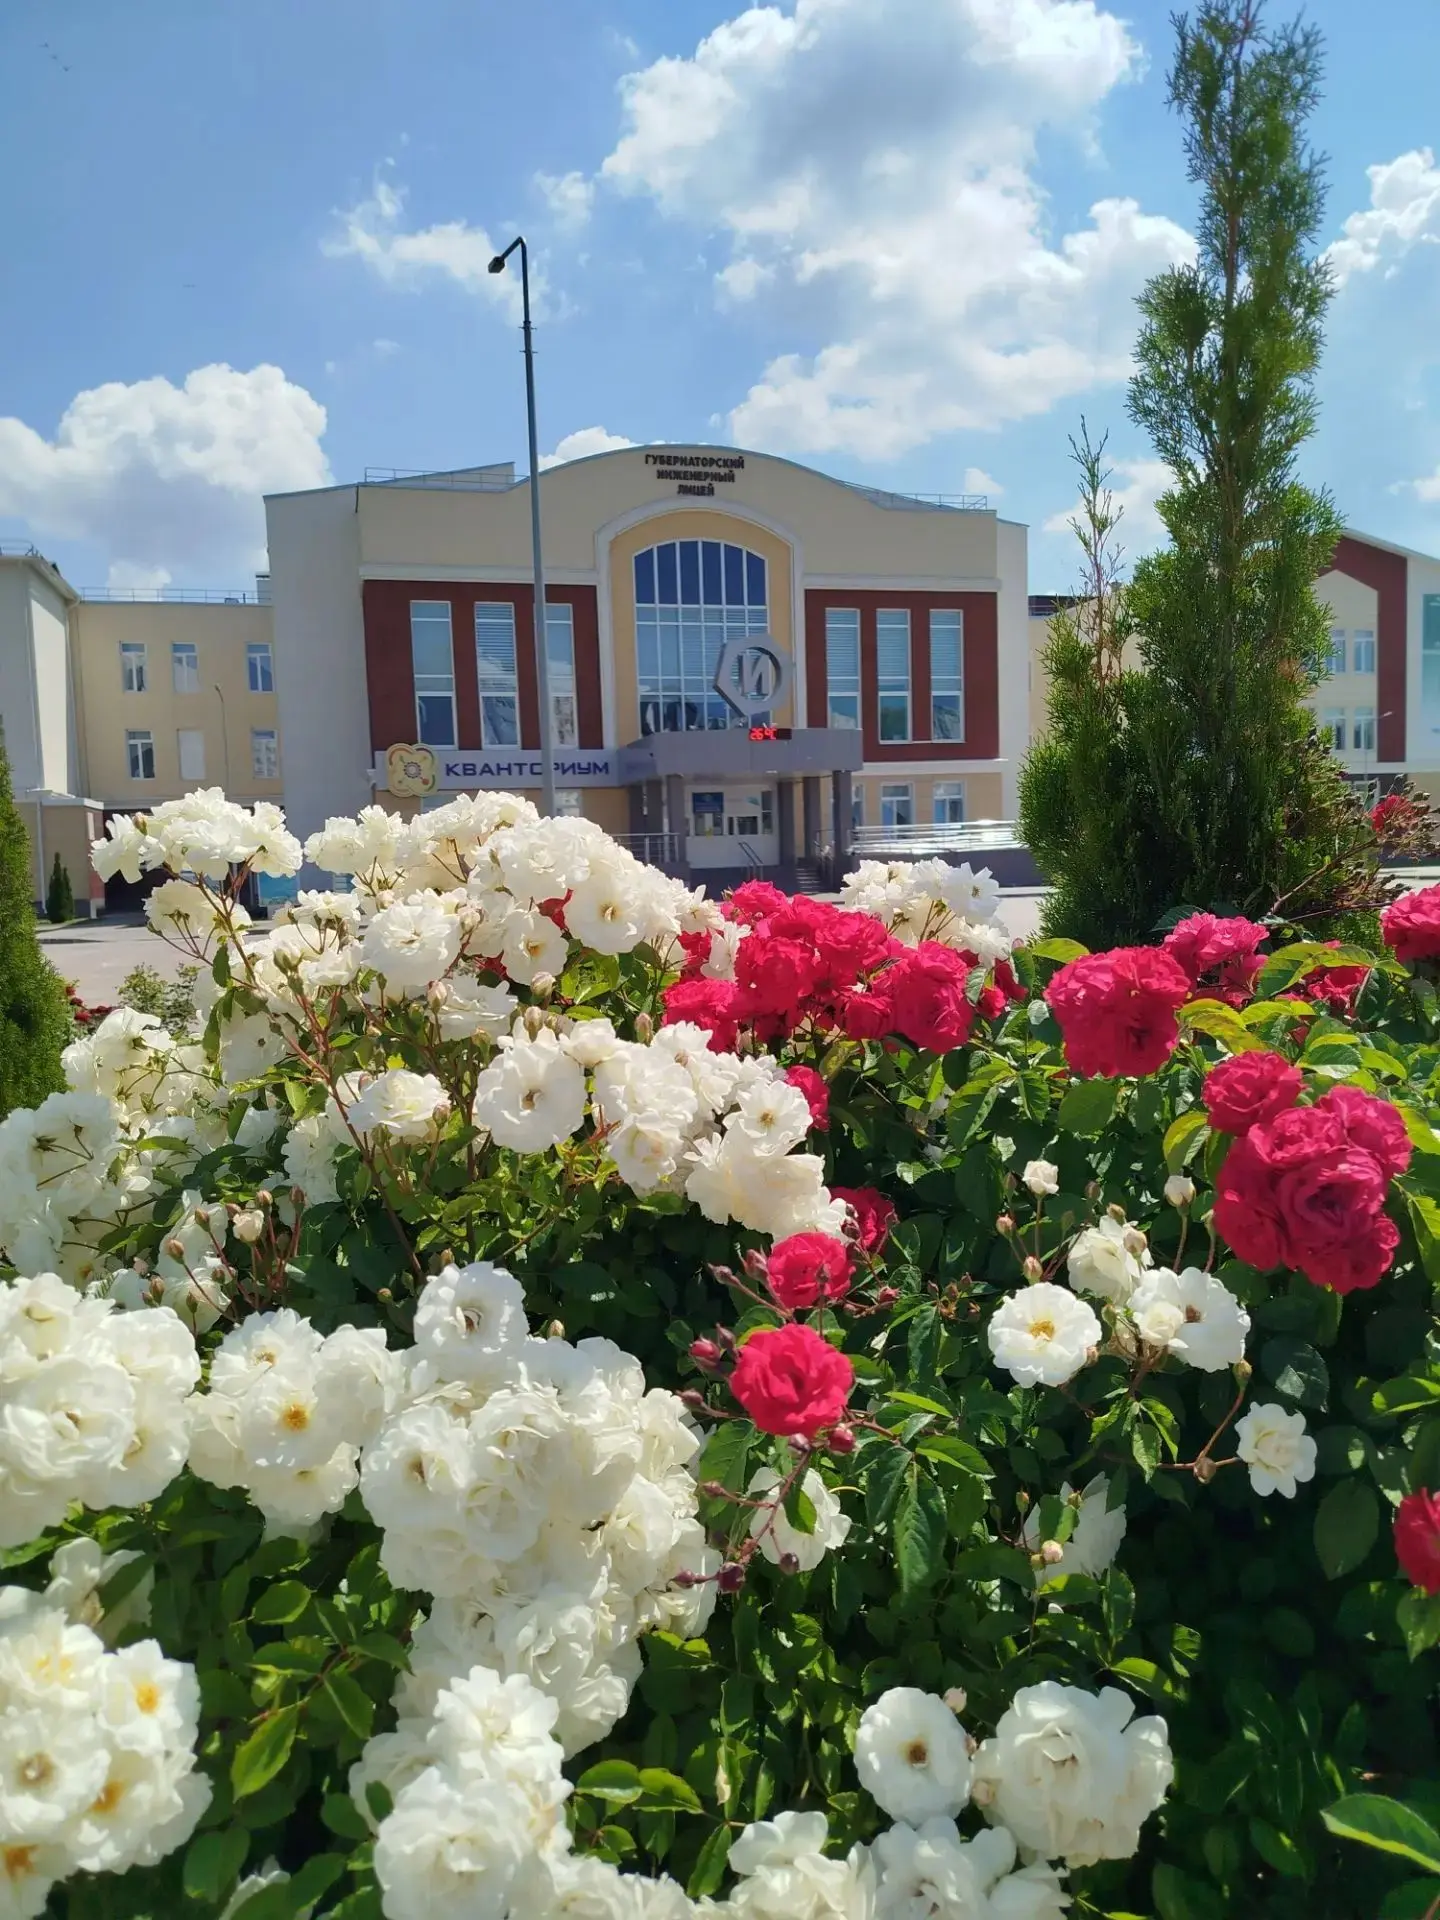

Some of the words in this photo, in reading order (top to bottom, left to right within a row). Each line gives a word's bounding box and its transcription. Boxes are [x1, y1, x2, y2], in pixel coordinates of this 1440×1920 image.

[644, 454, 745, 469] ГУБЕРНАТОРСКИЙ
[656, 469, 736, 483] ИНЖЕНЕРНЫЙ
[676, 482, 715, 496] ЛИЦЕЙ
